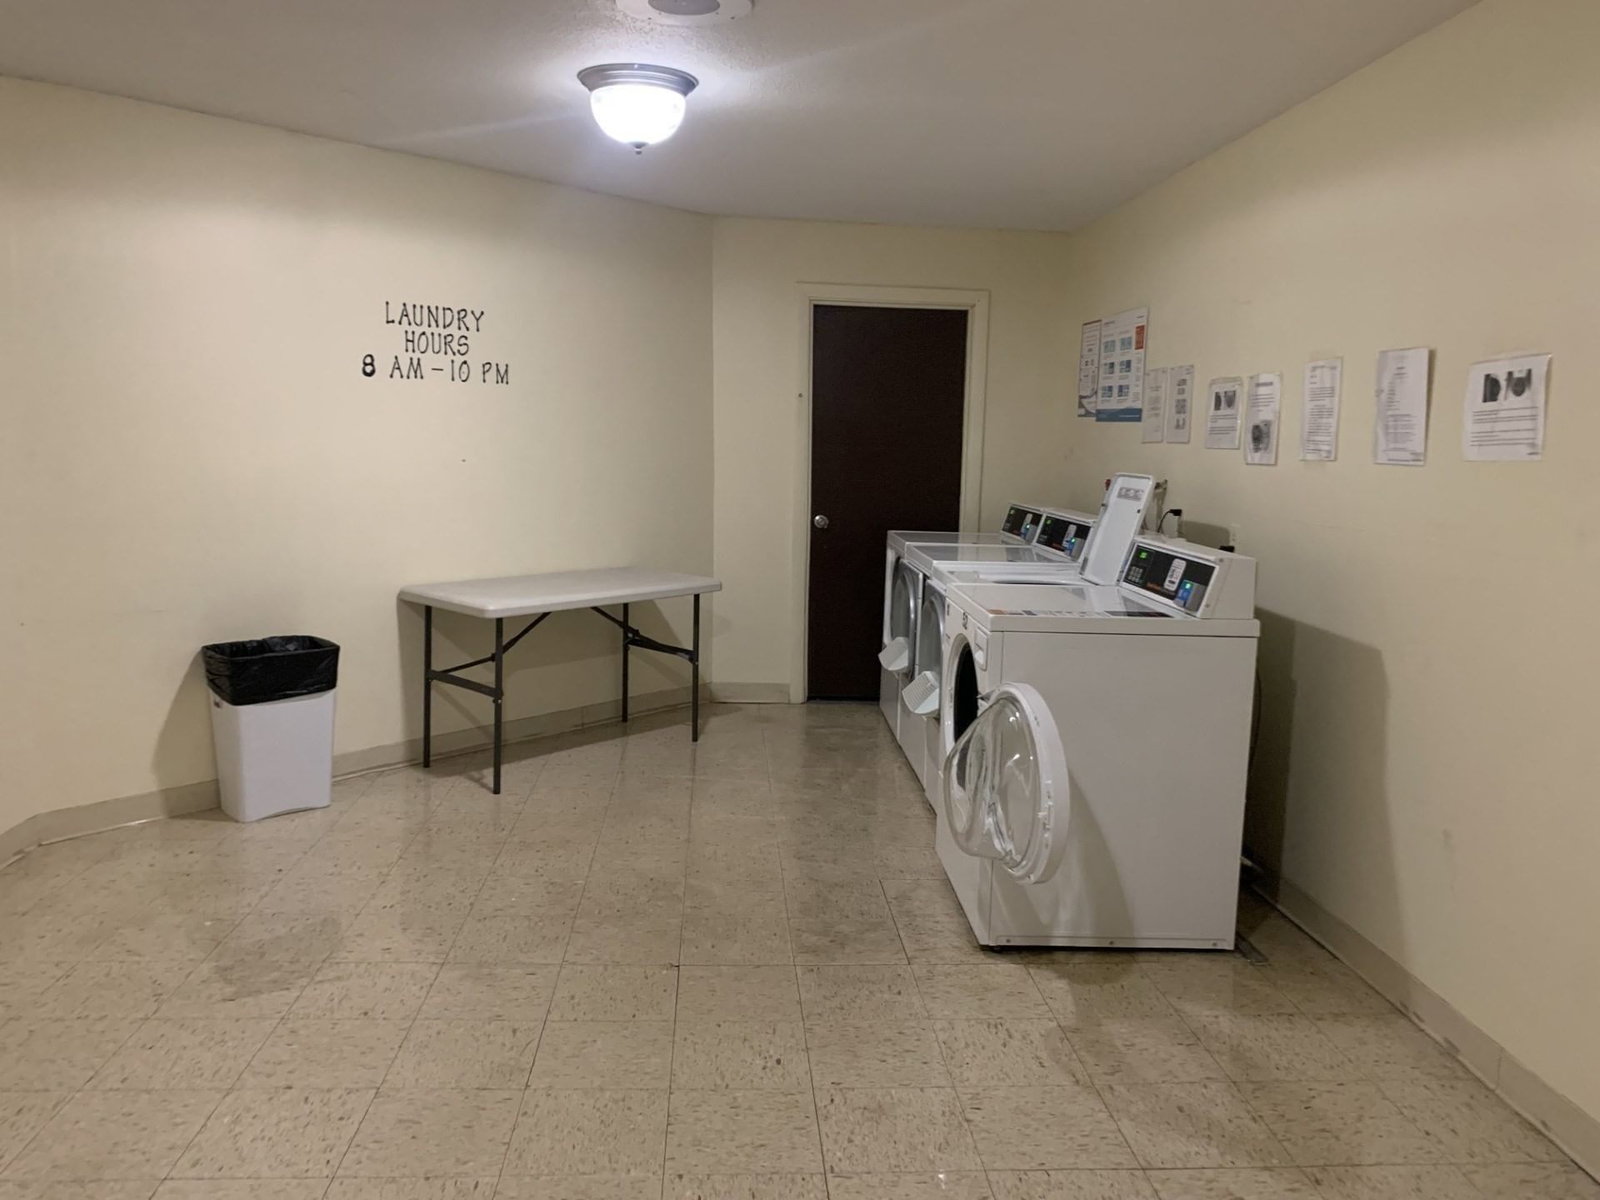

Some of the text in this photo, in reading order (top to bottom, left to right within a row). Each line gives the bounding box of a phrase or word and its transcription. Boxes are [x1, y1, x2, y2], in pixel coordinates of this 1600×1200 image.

[385, 300, 485, 332] LAUNDRY
[404, 330, 470, 356] HOURS
[361, 353, 377, 377] 8
[483, 361, 509, 384] PM
